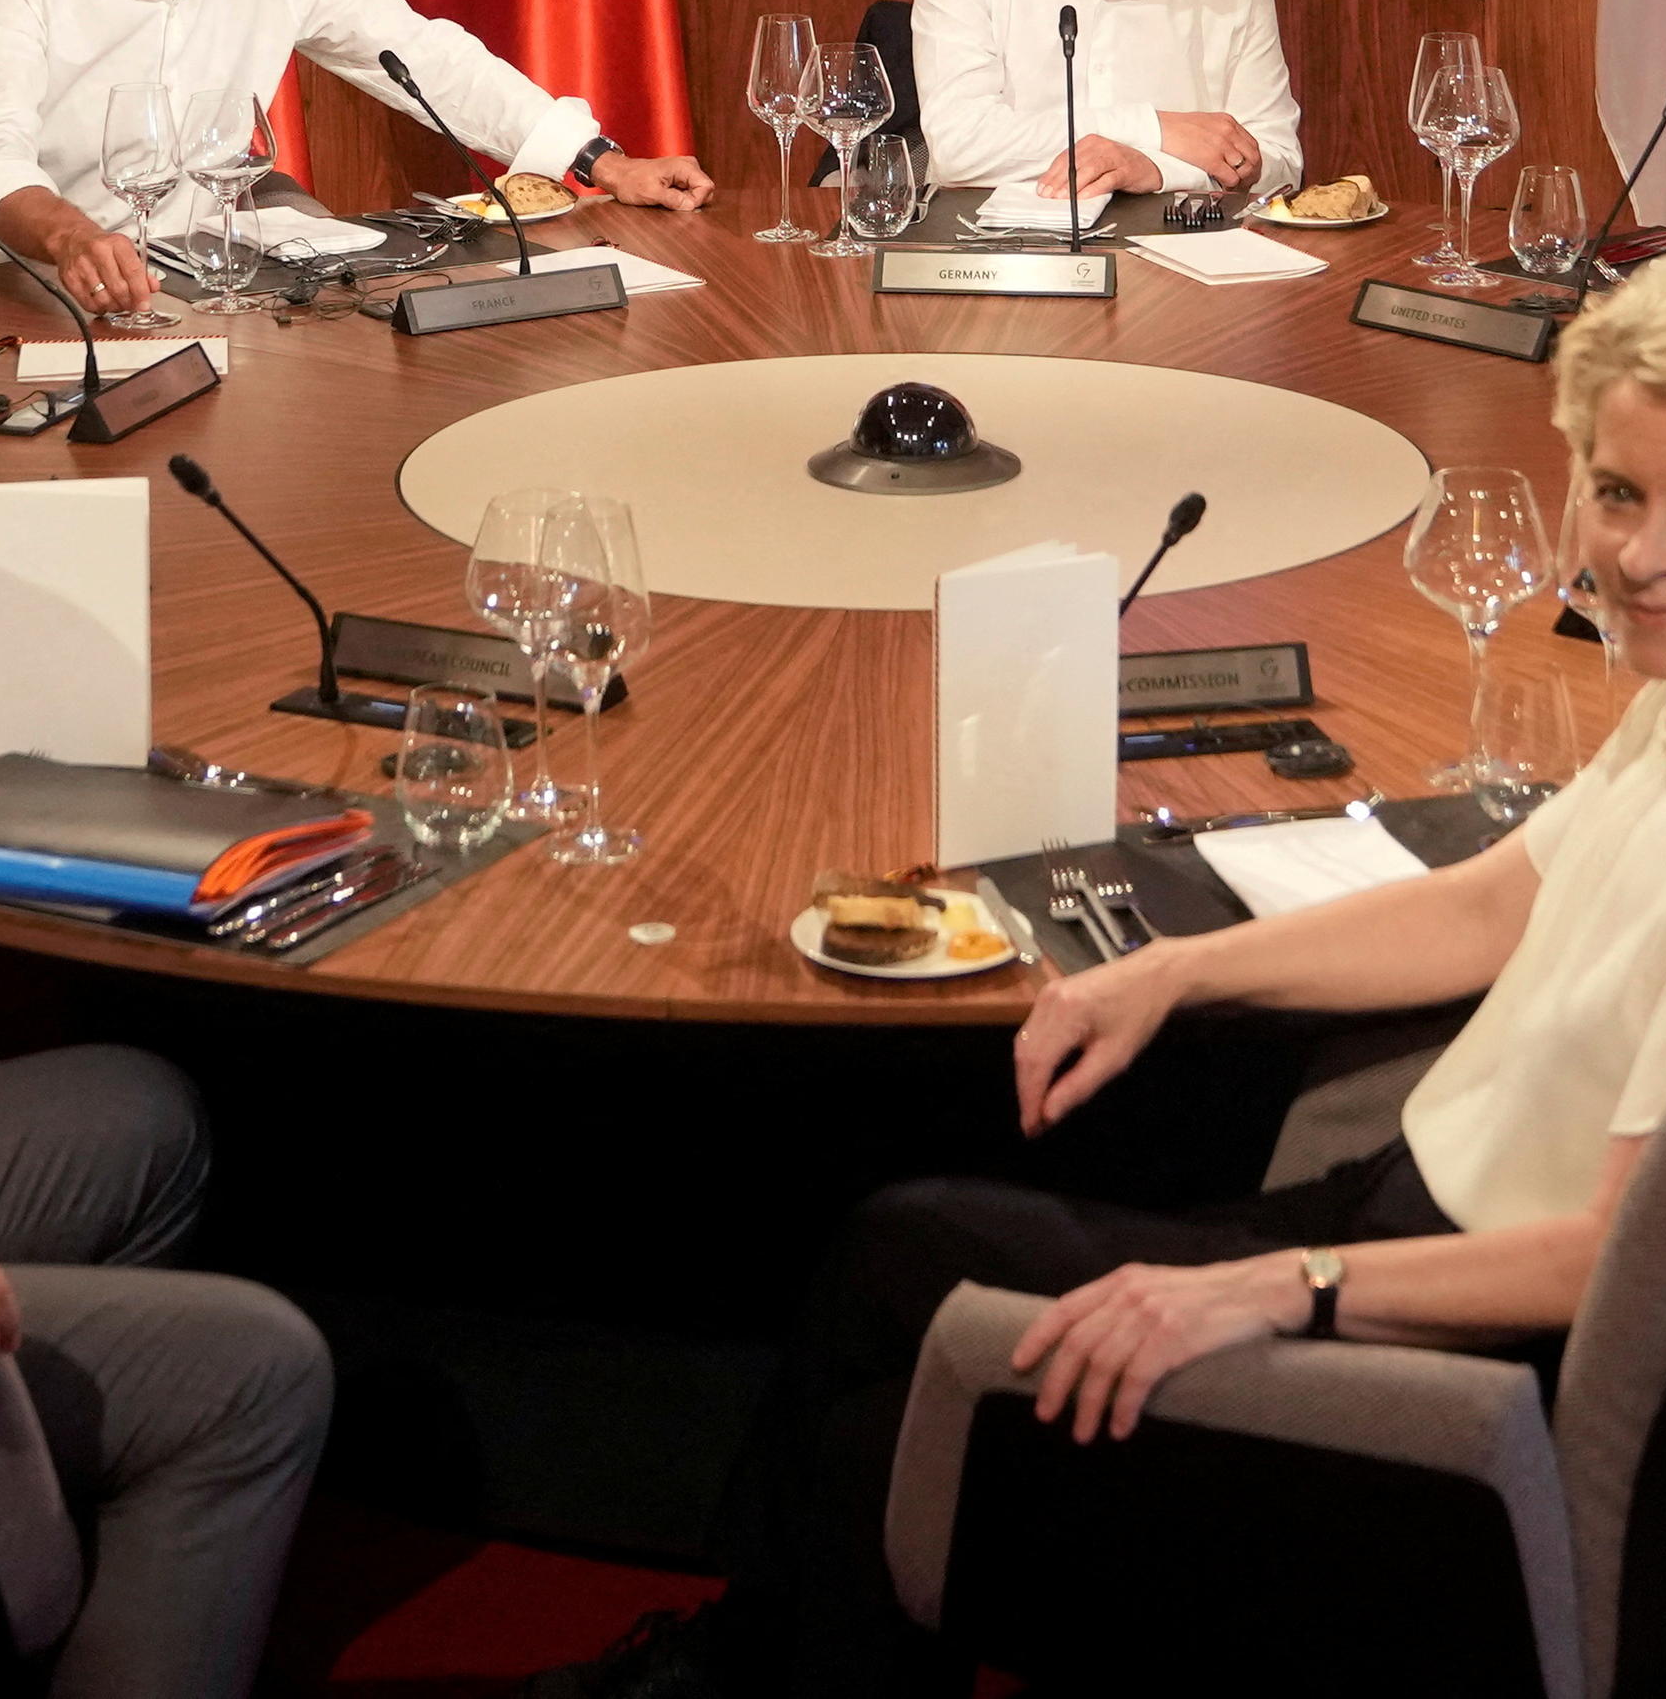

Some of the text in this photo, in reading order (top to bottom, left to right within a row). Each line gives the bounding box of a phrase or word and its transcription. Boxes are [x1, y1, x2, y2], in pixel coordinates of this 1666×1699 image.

[938, 268, 998, 281] GERMANY
[470, 295, 517, 312] FRANCE
[1390, 304, 1468, 330] UNITED STATES
[450, 655, 512, 677] COUNCIL
[1126, 671, 1240, 693] COMMISSION
